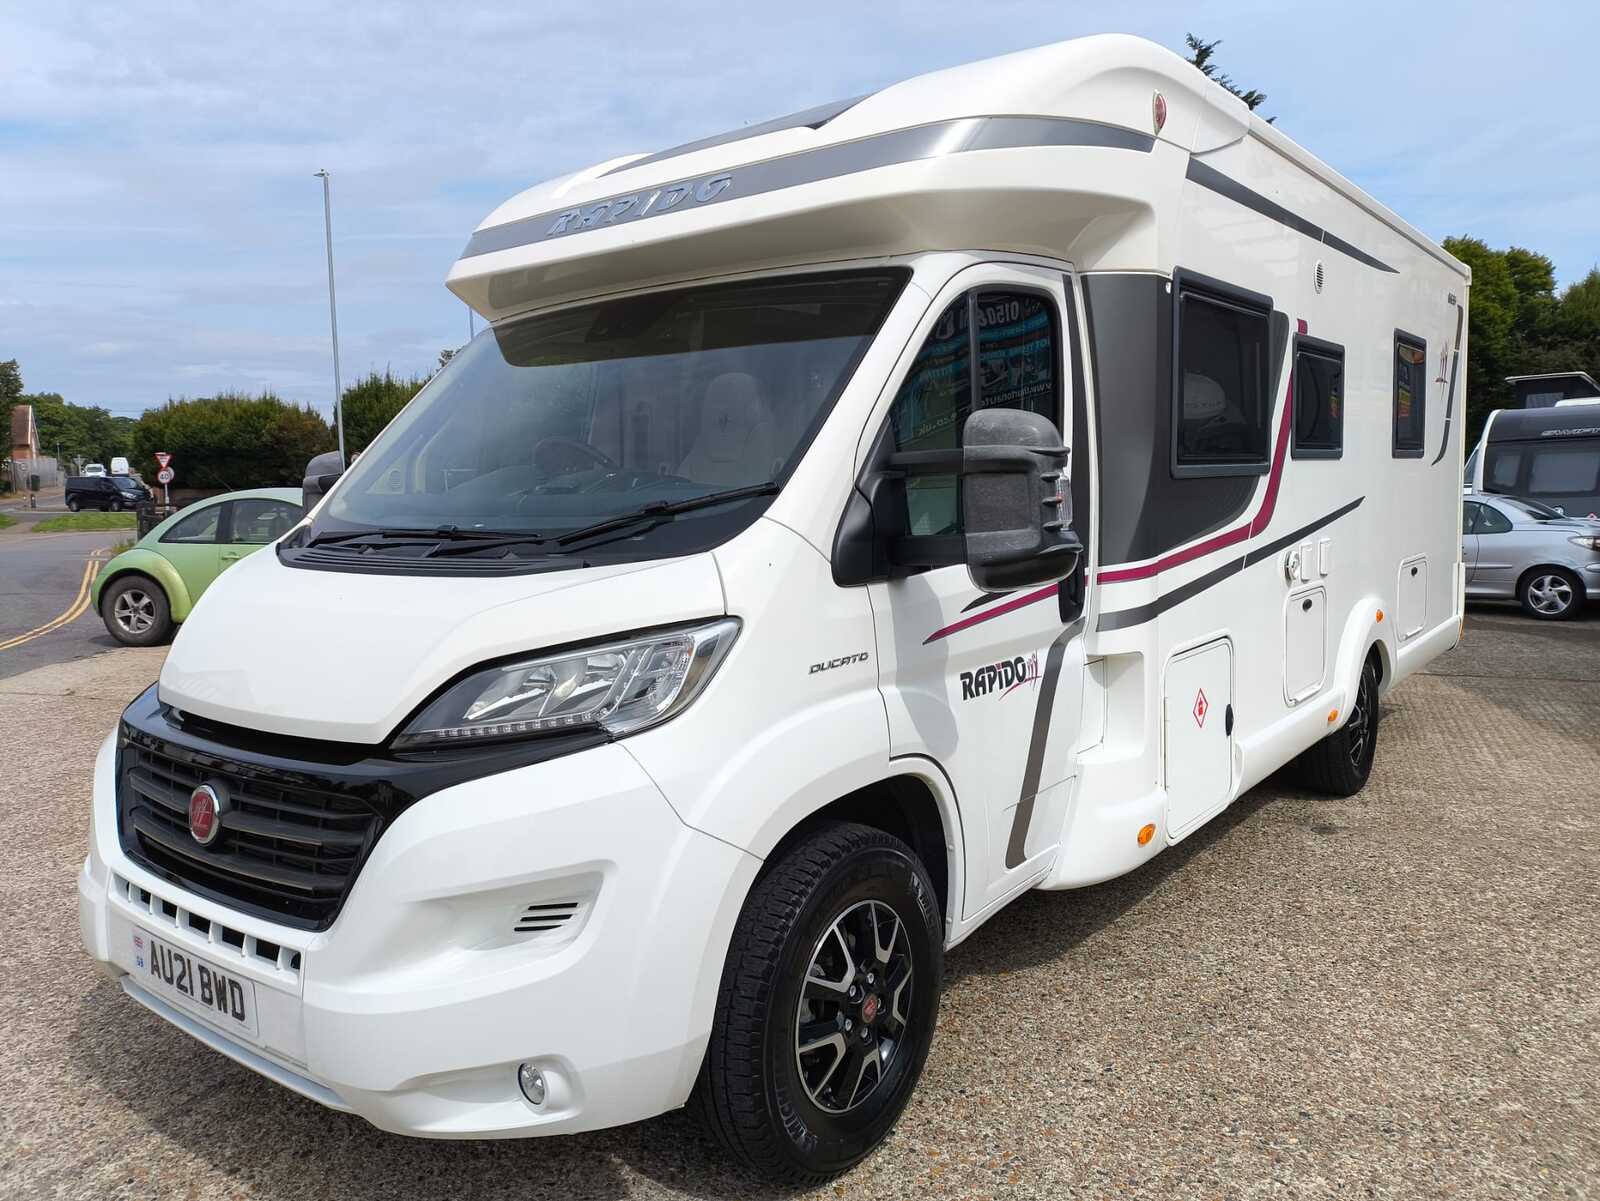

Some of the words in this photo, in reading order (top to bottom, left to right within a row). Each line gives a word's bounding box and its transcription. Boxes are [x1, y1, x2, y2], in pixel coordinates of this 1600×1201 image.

[547, 173, 733, 236] RAPIDO
[809, 652, 869, 675] DUCATO
[960, 657, 1027, 701] RAPIDO
[150, 940, 194, 996] AU21
[197, 963, 246, 1022] BWD
